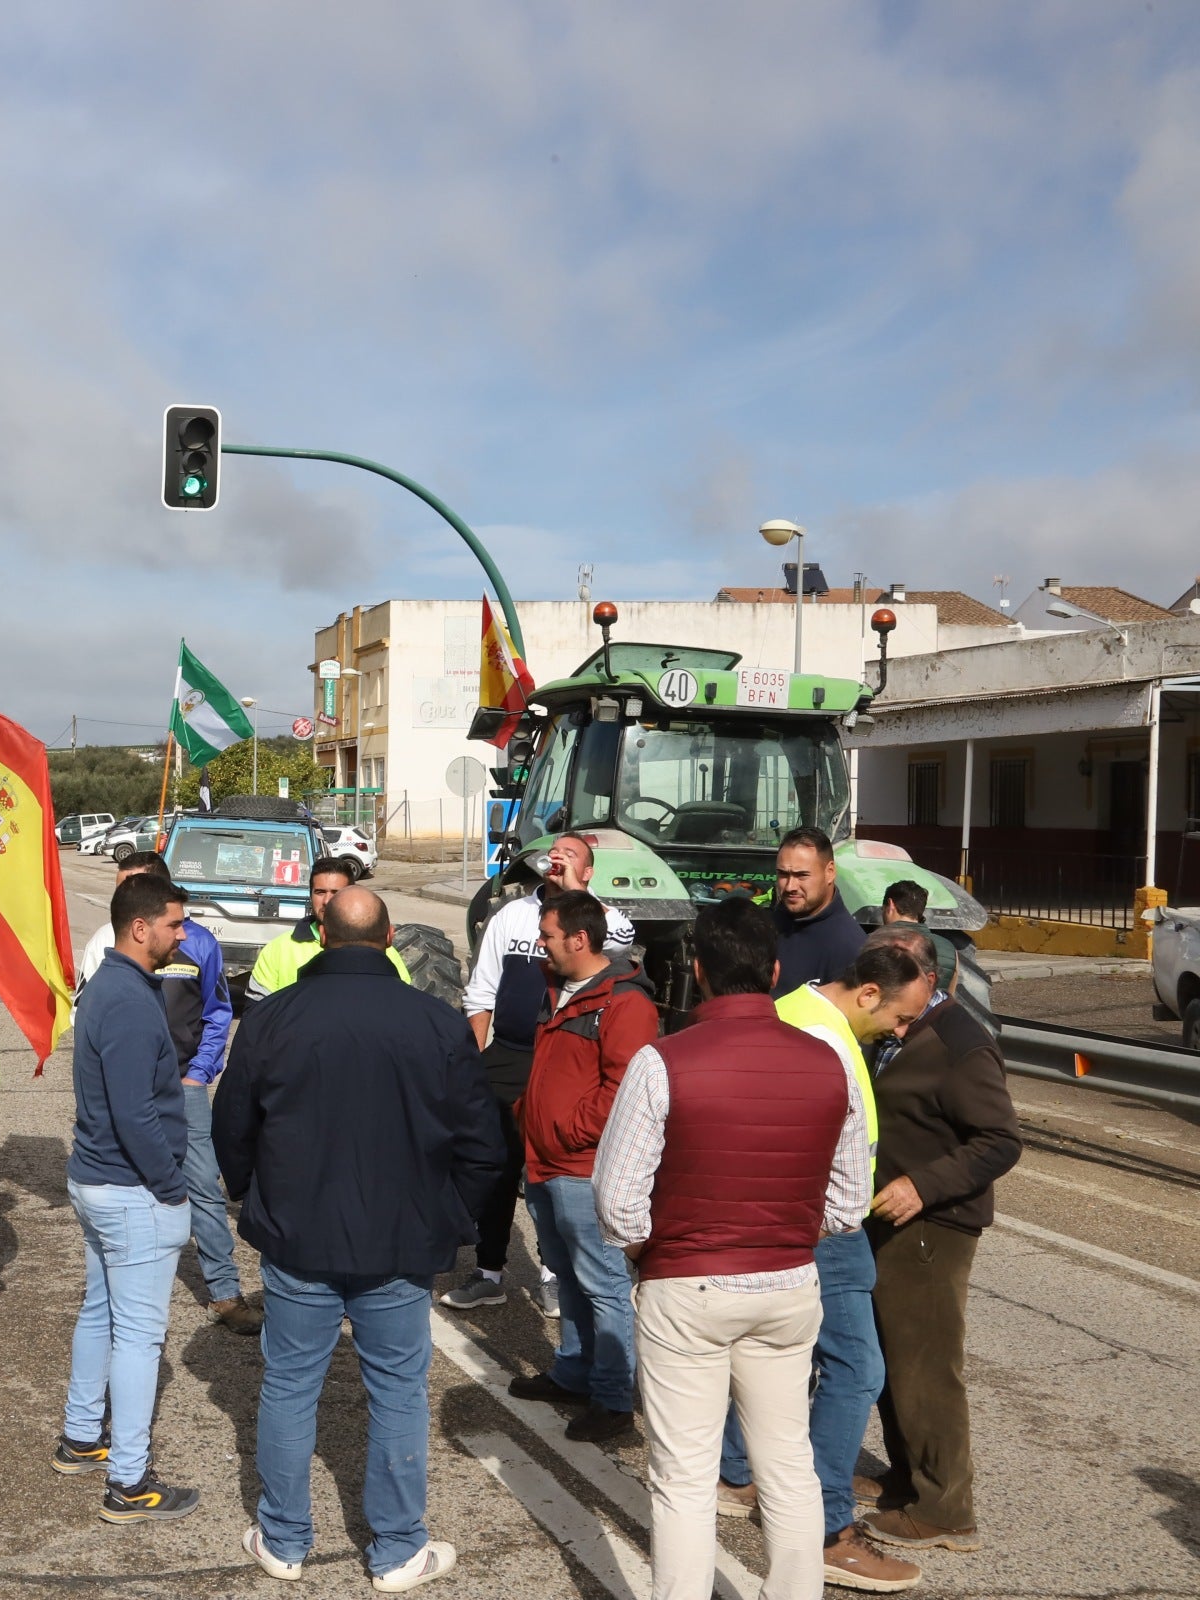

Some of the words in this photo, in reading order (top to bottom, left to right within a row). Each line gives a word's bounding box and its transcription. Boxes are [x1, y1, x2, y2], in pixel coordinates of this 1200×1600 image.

[664, 672, 688, 702] 40
[741, 671, 748, 683] E
[753, 672, 785, 687] 6035
[748, 689, 776, 704] BFN
